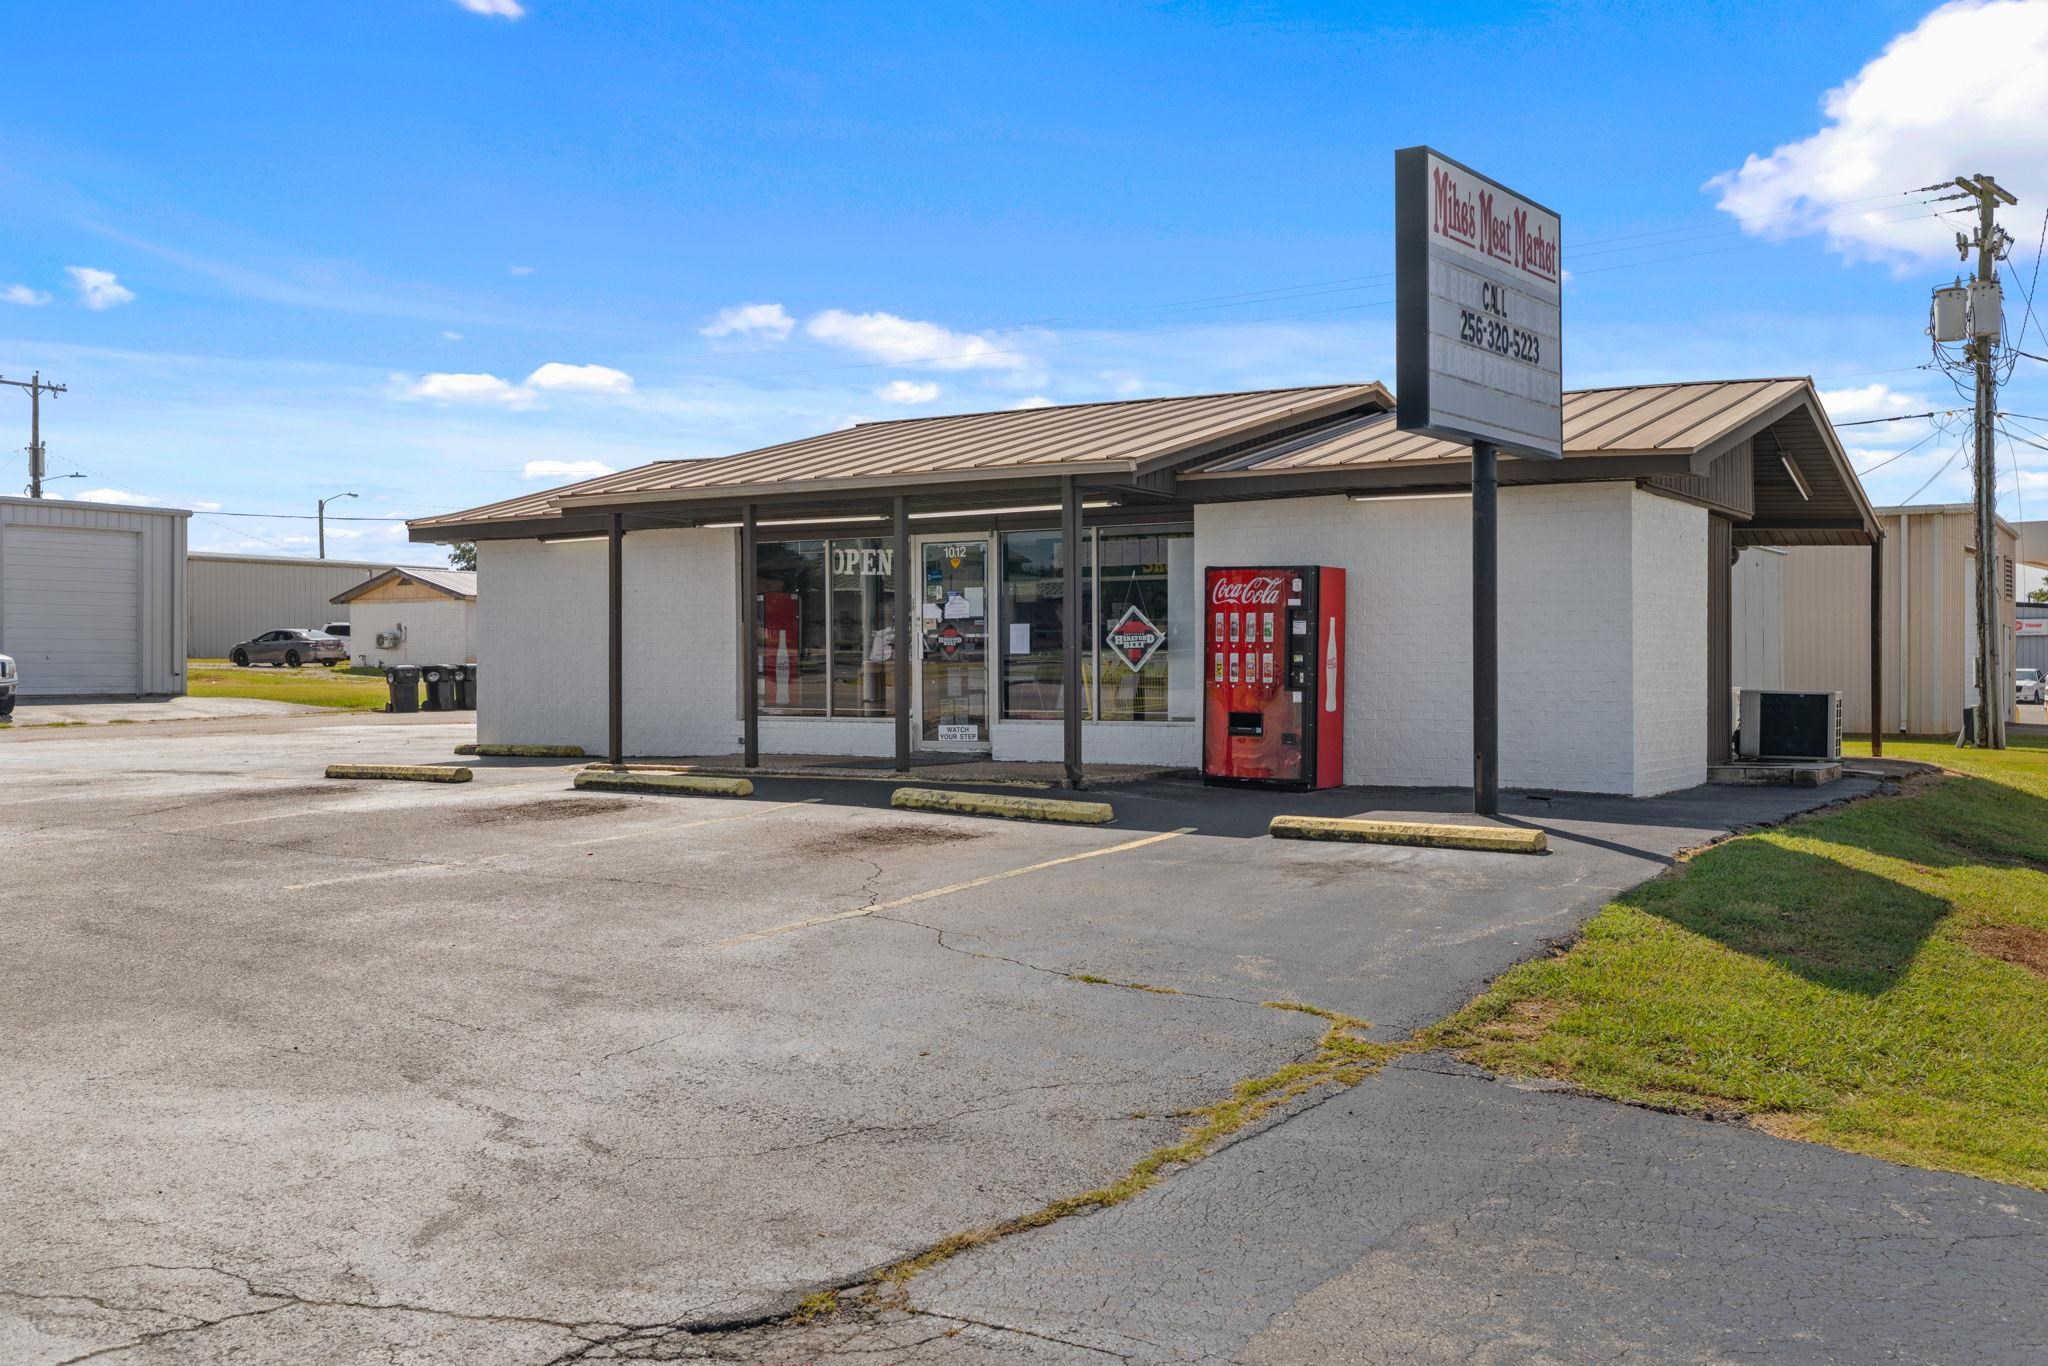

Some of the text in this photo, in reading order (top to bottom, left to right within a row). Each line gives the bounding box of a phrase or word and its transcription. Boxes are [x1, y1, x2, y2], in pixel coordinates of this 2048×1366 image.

[1434, 166, 1556, 276] Mike's Meat Market
[1482, 281, 1507, 318] CALL
[1460, 310, 1540, 365] 256-320-5223
[832, 548, 894, 576] OPEN
[943, 546, 966, 558] 1012
